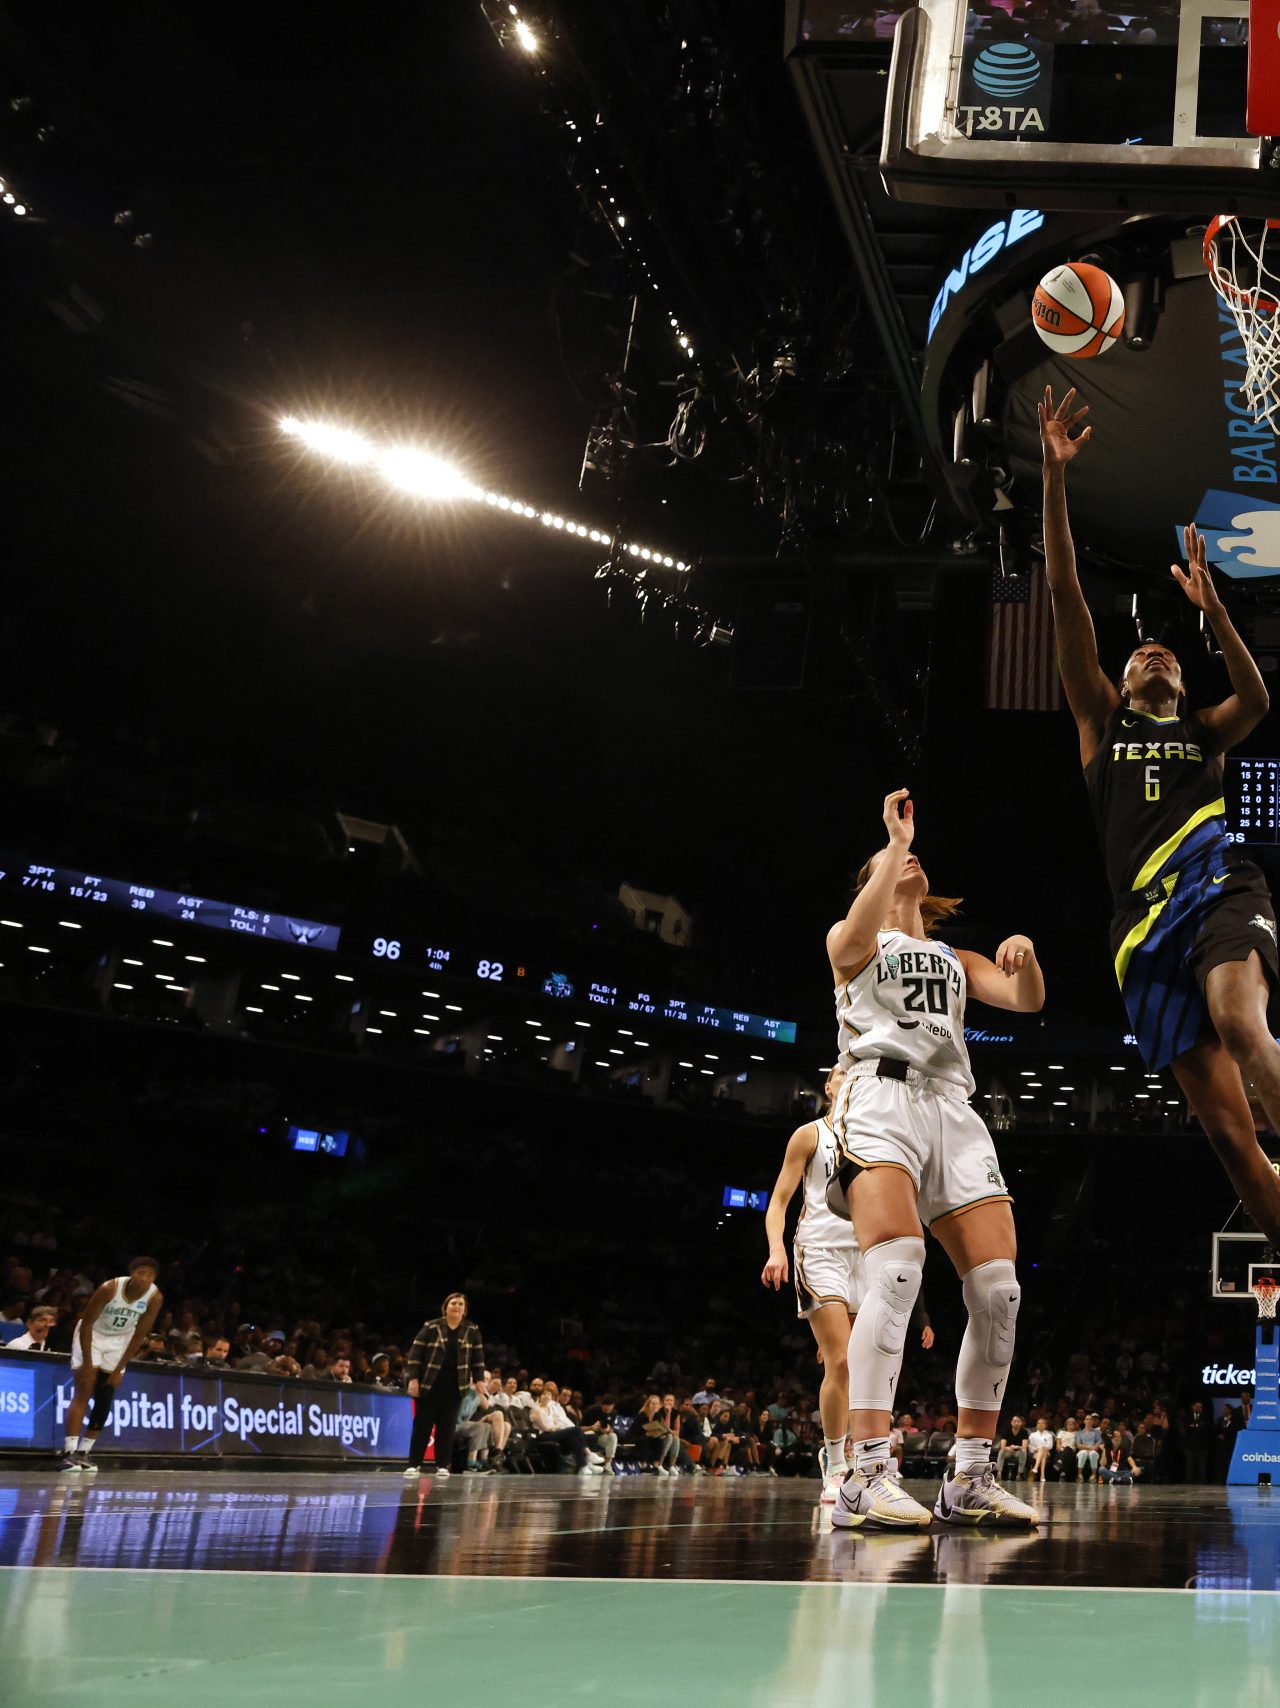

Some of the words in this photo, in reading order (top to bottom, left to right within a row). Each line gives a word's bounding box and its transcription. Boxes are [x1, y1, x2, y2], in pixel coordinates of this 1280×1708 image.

[1113, 742, 1202, 762] TEXAS
[1145, 765, 1160, 801] 6
[1269, 772, 1275, 780] 3
[1270, 784, 1275, 792] 1
[1268, 796, 1275, 804] 3
[1268, 808, 1275, 816] 2
[1268, 820, 1274, 828] 3
[28, 865, 55, 877] 3PT
[84, 876, 101, 886] FT
[129, 886, 155, 898] REB
[177, 896, 203, 908] AST
[263, 914, 270, 923] 5
[131, 899, 146, 910] 39
[181, 910, 195, 920] 24
[261, 926, 267, 935] 1
[372, 937, 401, 960] 96
[426, 947, 450, 961] 1:04
[476, 959, 504, 981] 82
[429, 961, 443, 971] 4th
[591, 983, 611, 994] FLS:
[611, 987, 617, 995] 4
[638, 993, 650, 1002] FG
[669, 1000, 685, 1009] 3PT
[704, 1007, 716, 1015] FT
[733, 1013, 749, 1022] REB
[764, 1019, 780, 1028] AST
[902, 978, 948, 1015] 20
[588, 993, 609, 1005] TOL:
[610, 998, 615, 1006] 1
[735, 1024, 745, 1032] 34
[767, 1030, 776, 1038] 19
[112, 1317, 128, 1328] 13
[56, 1384, 174, 1436] Hpital
[181, 1394, 217, 1431] for
[224, 1397, 303, 1440] Special
[308, 1404, 380, 1446] Surgery
